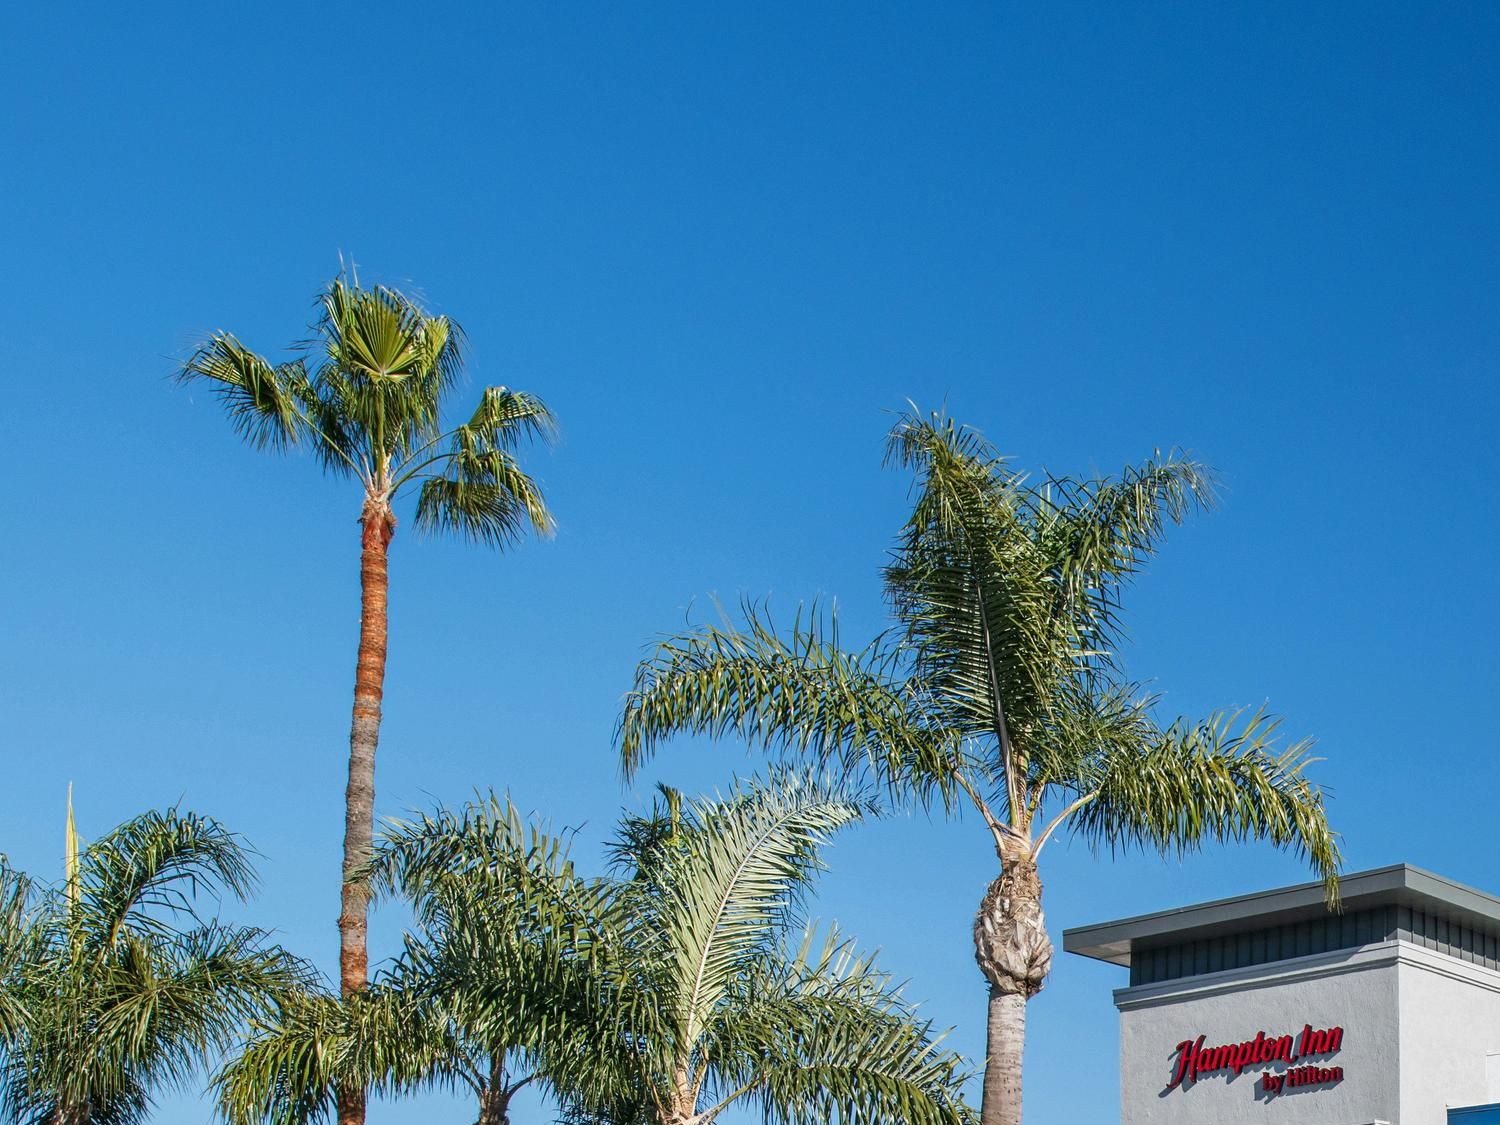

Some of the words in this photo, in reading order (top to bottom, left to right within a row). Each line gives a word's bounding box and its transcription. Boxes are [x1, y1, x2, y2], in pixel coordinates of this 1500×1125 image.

[1167, 1031, 1298, 1089] Hampton
[1299, 1024, 1344, 1057] Inn
[1262, 1072, 1283, 1095] by
[1286, 1065, 1344, 1088] Hilton
